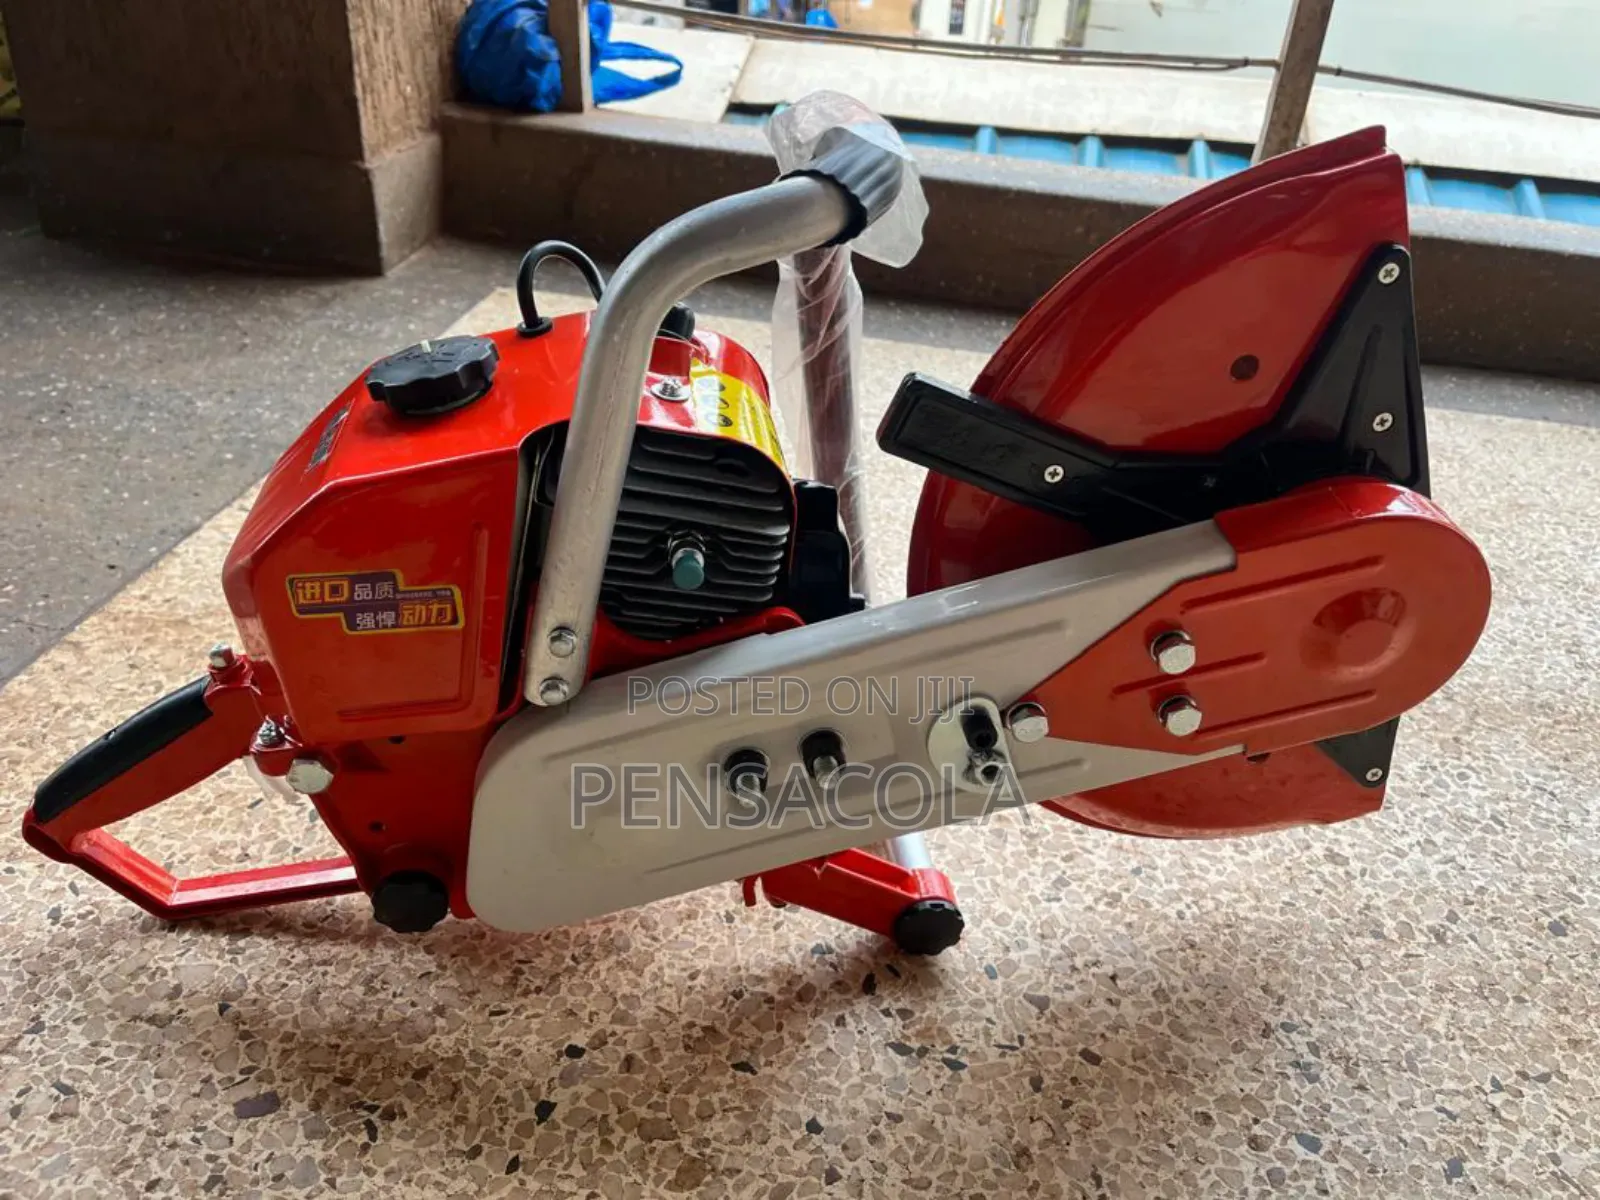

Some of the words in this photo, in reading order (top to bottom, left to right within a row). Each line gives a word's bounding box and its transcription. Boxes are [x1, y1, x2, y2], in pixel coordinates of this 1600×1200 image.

[296, 580, 395, 604] 进口品质
[356, 602, 452, 630] 强悍动力
